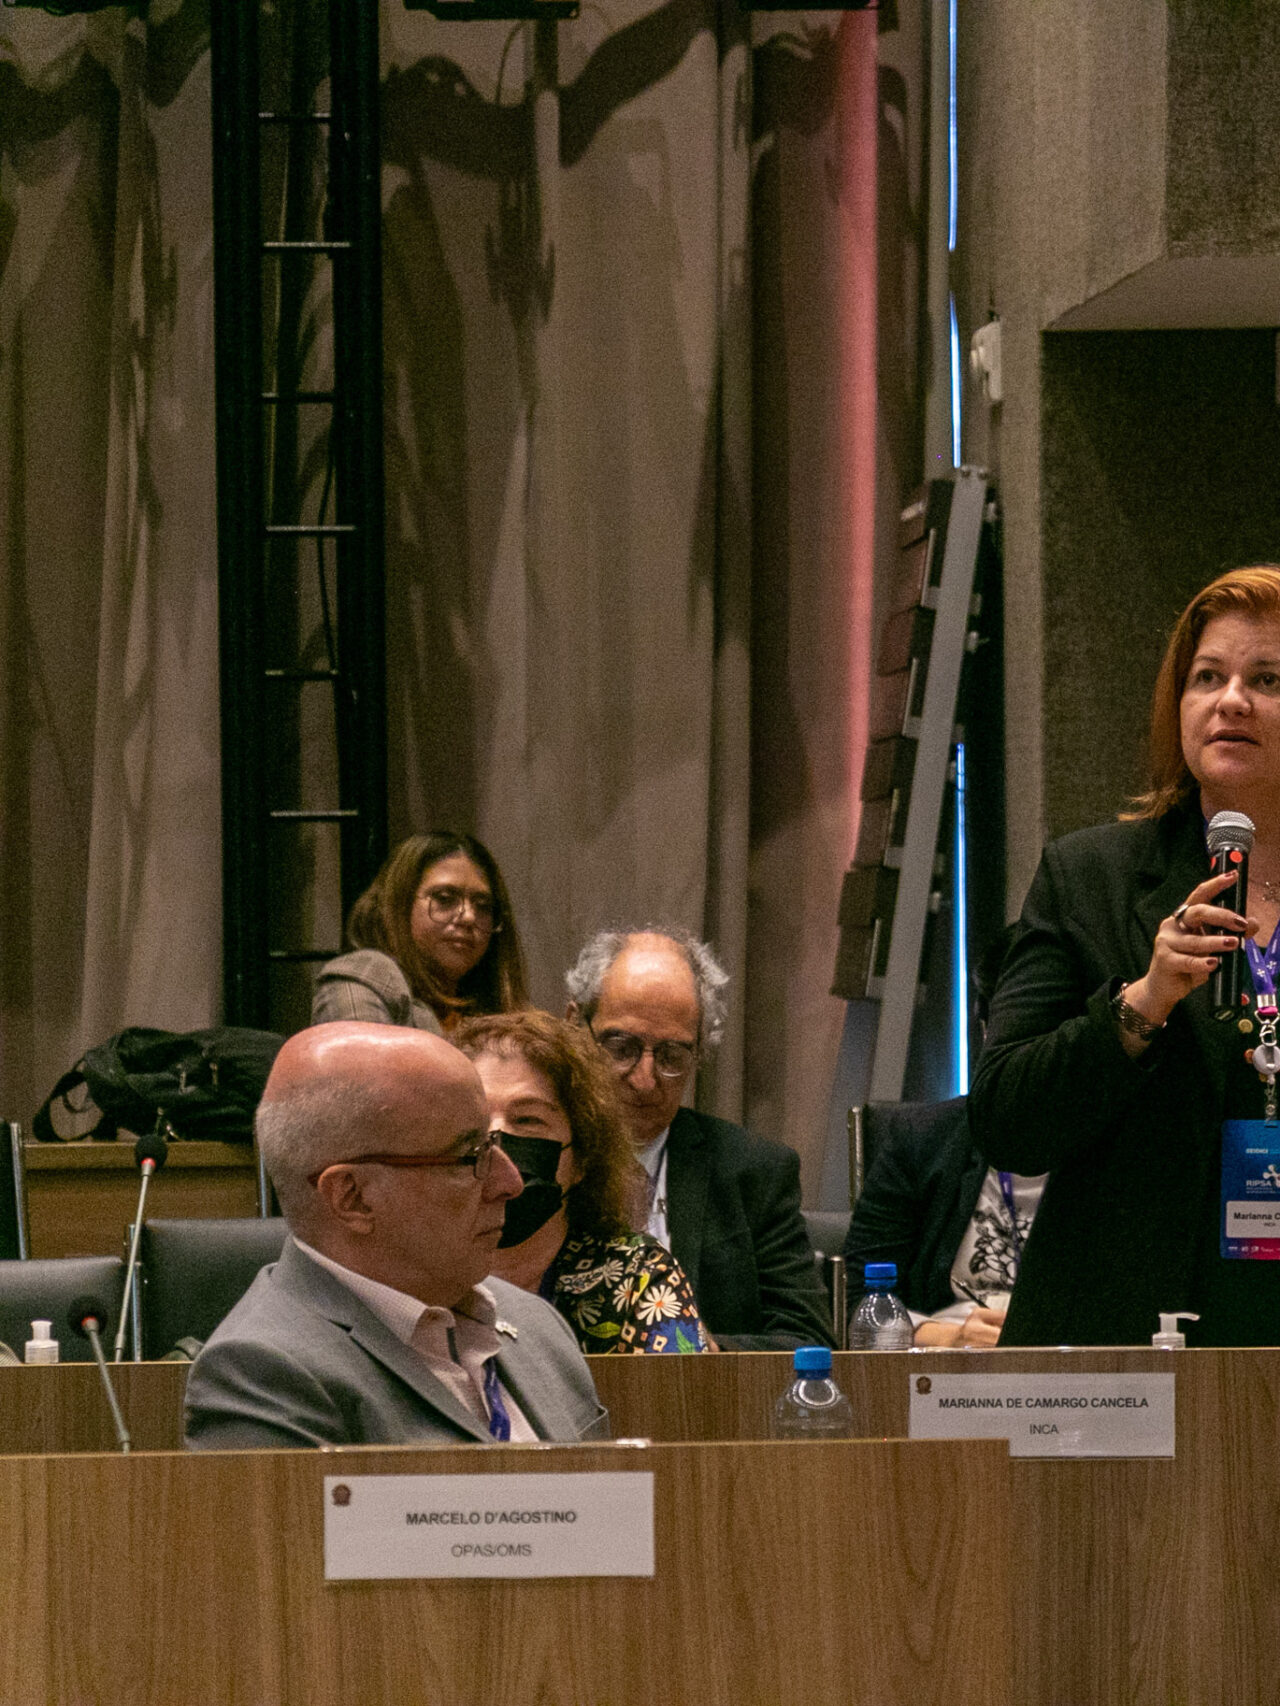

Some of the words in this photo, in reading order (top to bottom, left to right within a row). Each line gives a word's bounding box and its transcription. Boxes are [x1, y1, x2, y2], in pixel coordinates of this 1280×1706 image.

[938, 1397, 1003, 1409] MARIANNA
[1006, 1397, 1023, 1409] DE
[1025, 1397, 1089, 1409] CAMARGO
[1091, 1396, 1149, 1409] CANCELA
[1029, 1423, 1060, 1435] INCA
[405, 1511, 481, 1526] MARCELO
[484, 1510, 578, 1526] D'AGOSTINO
[450, 1542, 533, 1558] OPAS/OMS
